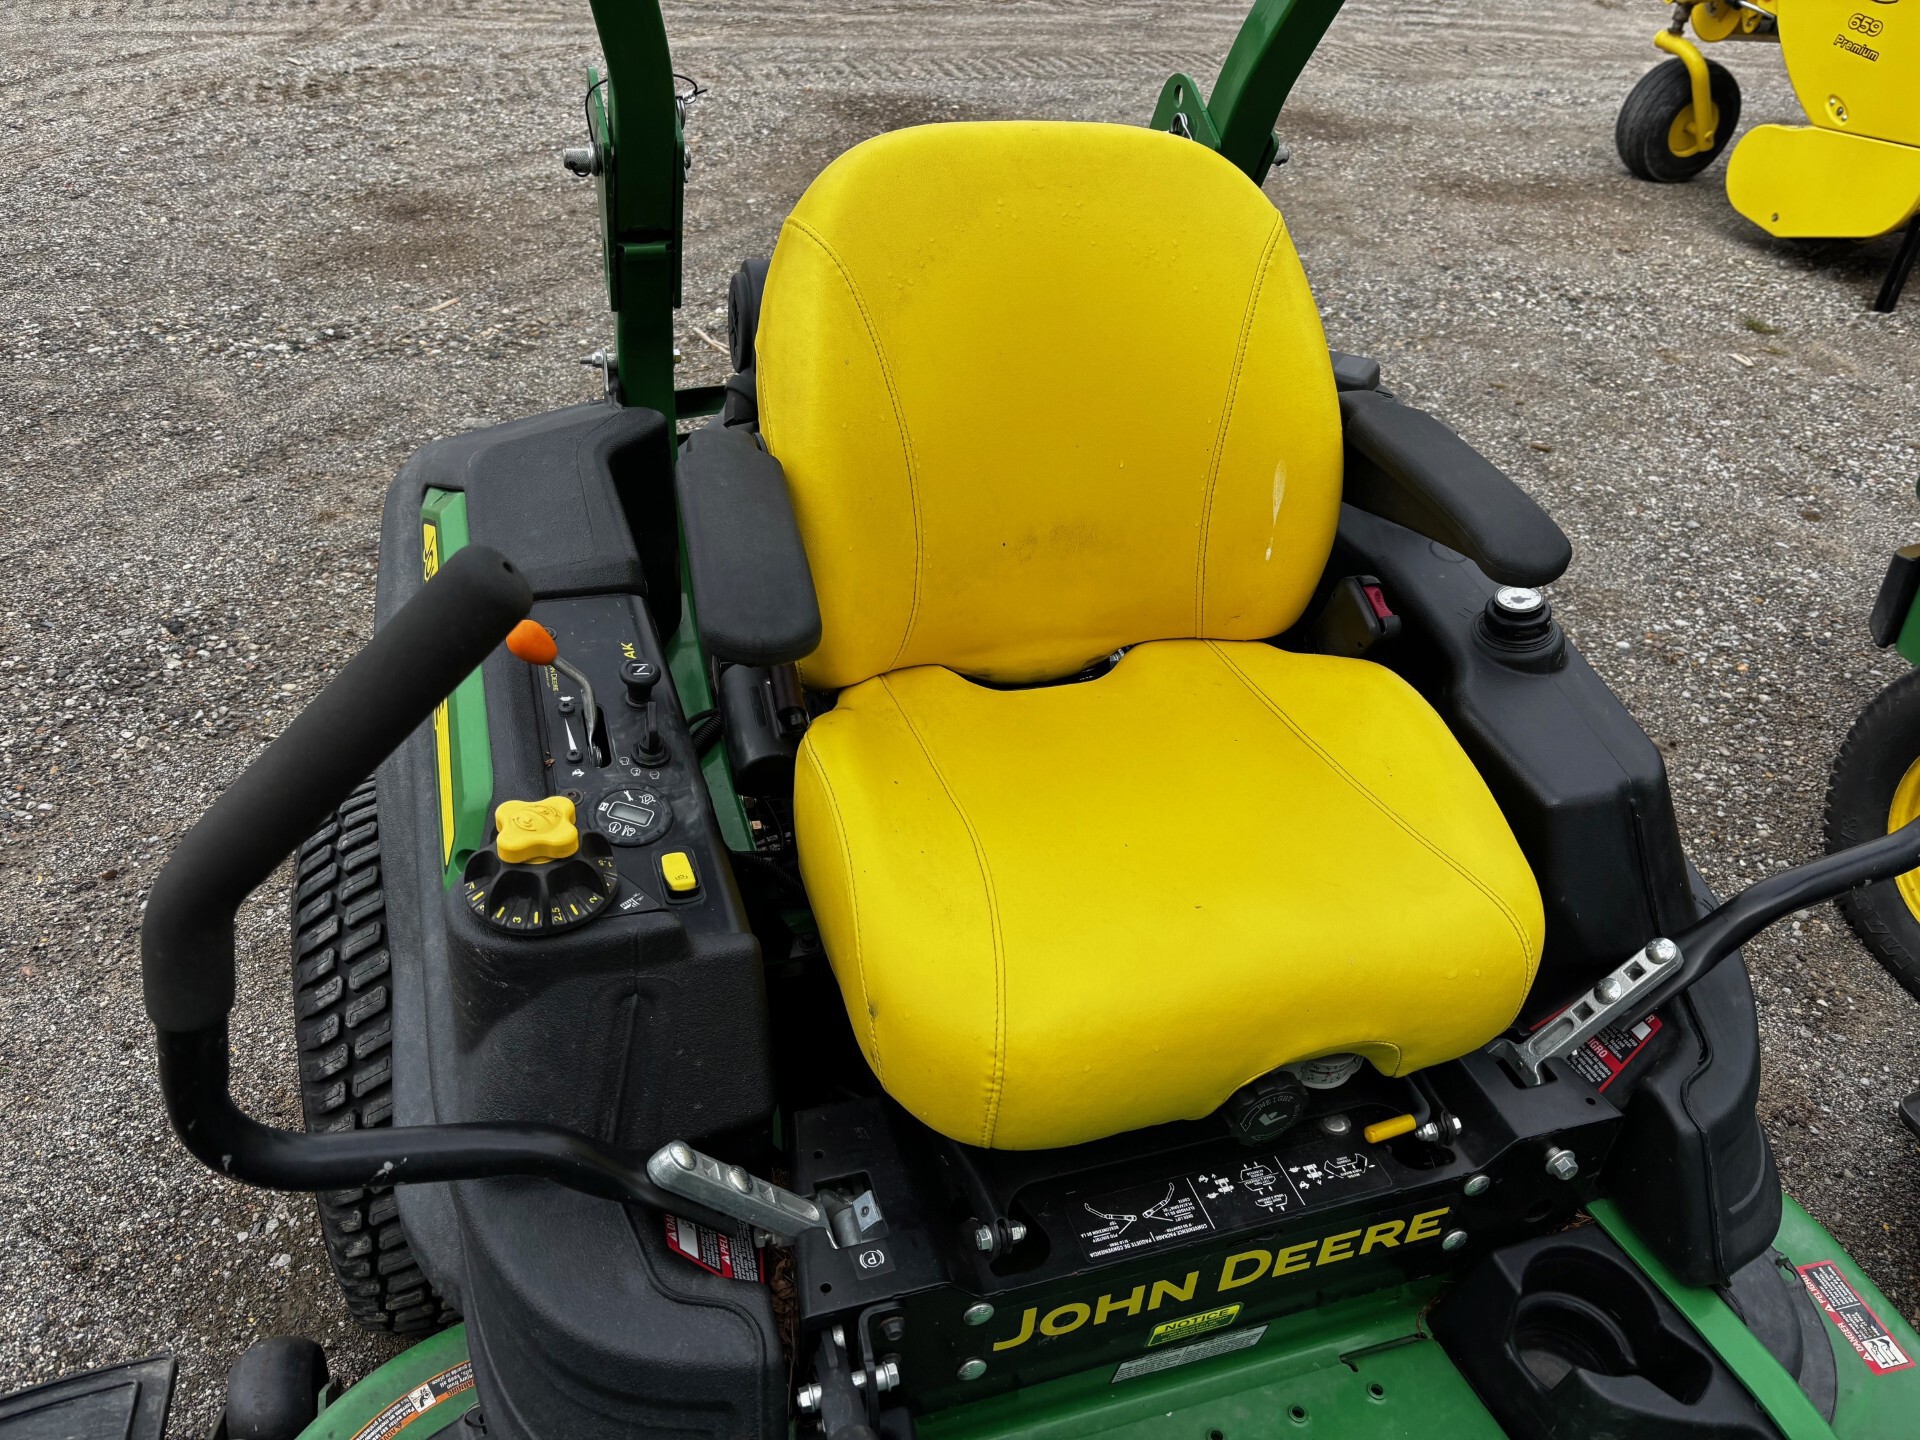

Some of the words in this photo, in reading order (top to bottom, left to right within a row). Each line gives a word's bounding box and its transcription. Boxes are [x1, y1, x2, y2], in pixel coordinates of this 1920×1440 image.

[1848, 13, 1883, 37] 659
[1833, 34, 1879, 62] Premium
[512, 916, 522, 924] 3
[551, 907, 563, 922] 2.5
[1587, 1037, 1608, 1058] IGRO
[718, 1233, 728, 1254] PELI
[993, 1271, 1199, 1351] JOHN
[1217, 1207, 1450, 1291] DEERE
[1164, 1308, 1229, 1331] NOTICE
[1837, 1321, 1864, 1352] DANGER
[446, 1379, 474, 1397] ARNING
